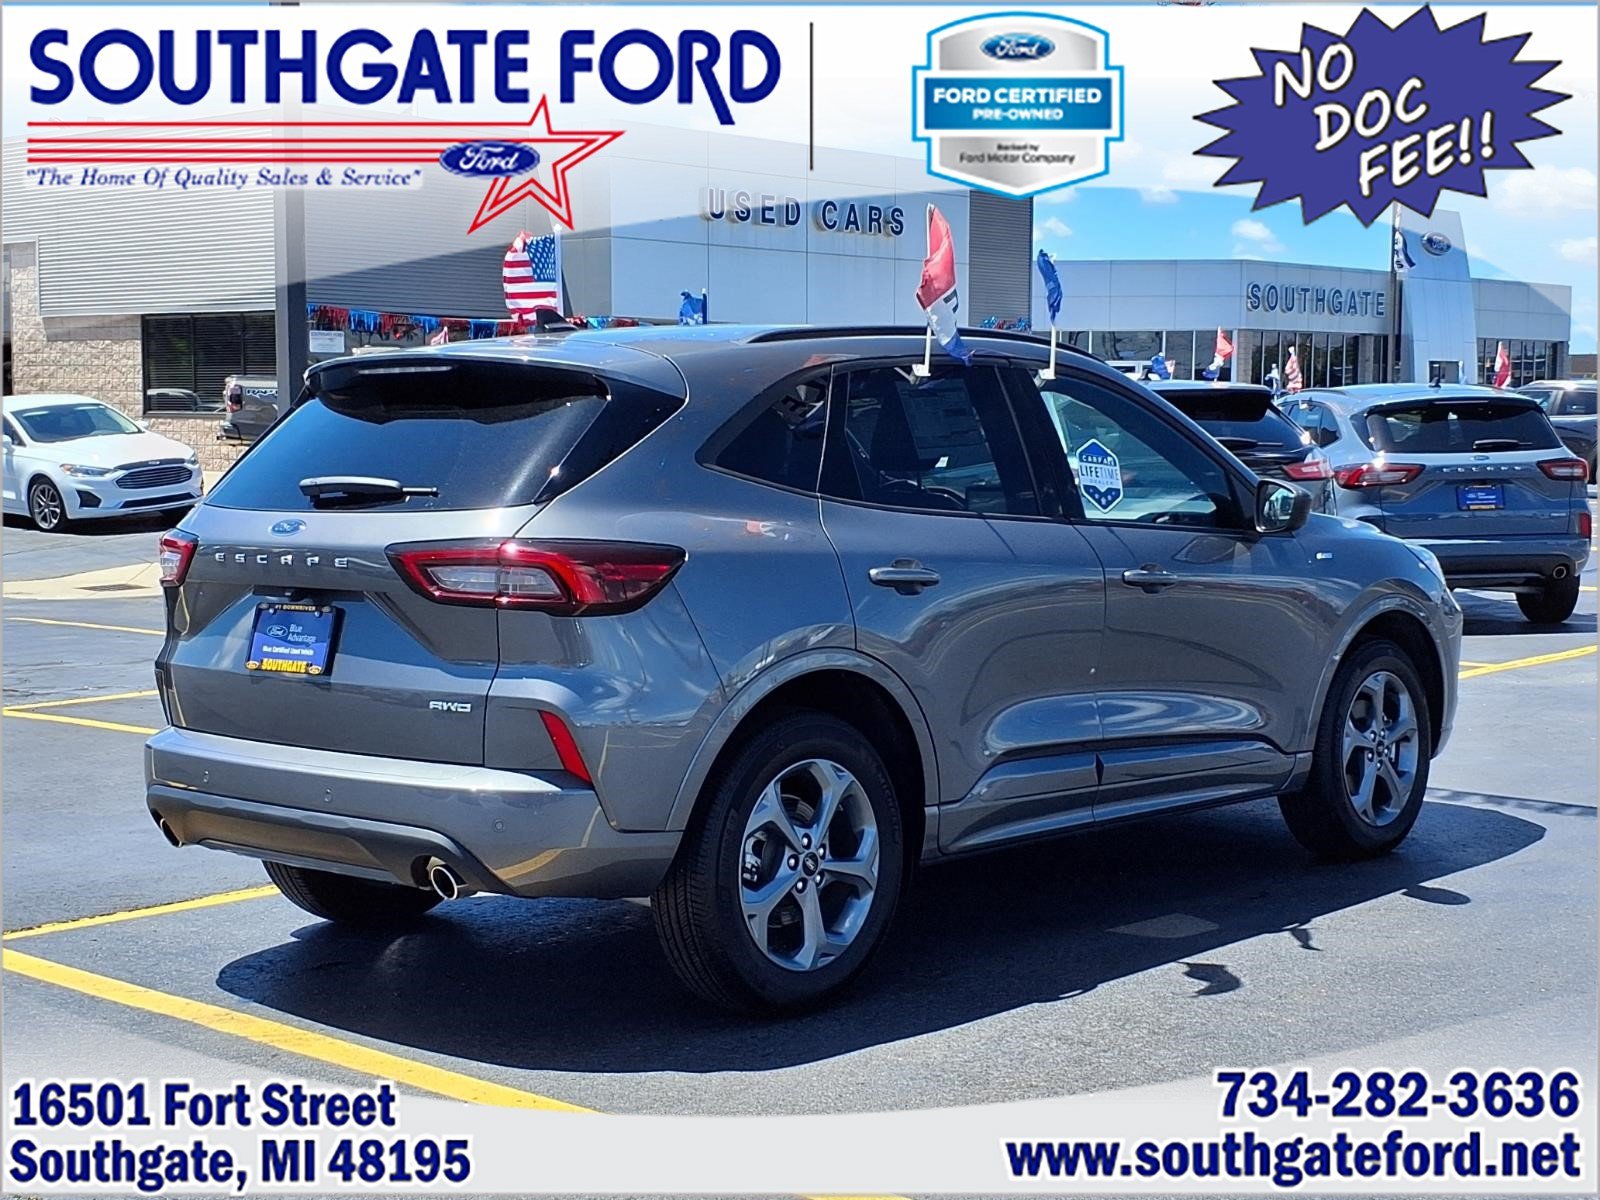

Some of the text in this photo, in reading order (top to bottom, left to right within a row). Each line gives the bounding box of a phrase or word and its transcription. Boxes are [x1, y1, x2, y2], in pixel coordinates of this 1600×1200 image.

[705, 187, 905, 238] USED CARS
[1247, 282, 1386, 317] SOUTHGATE
[1080, 465, 1120, 481] LIFETIME
[214, 551, 350, 568] ESCAPE
[289, 623, 303, 633] Blue
[287, 632, 317, 645] Advantage
[261, 657, 307, 674] SOUTHGATE
[429, 700, 472, 713] AWD
